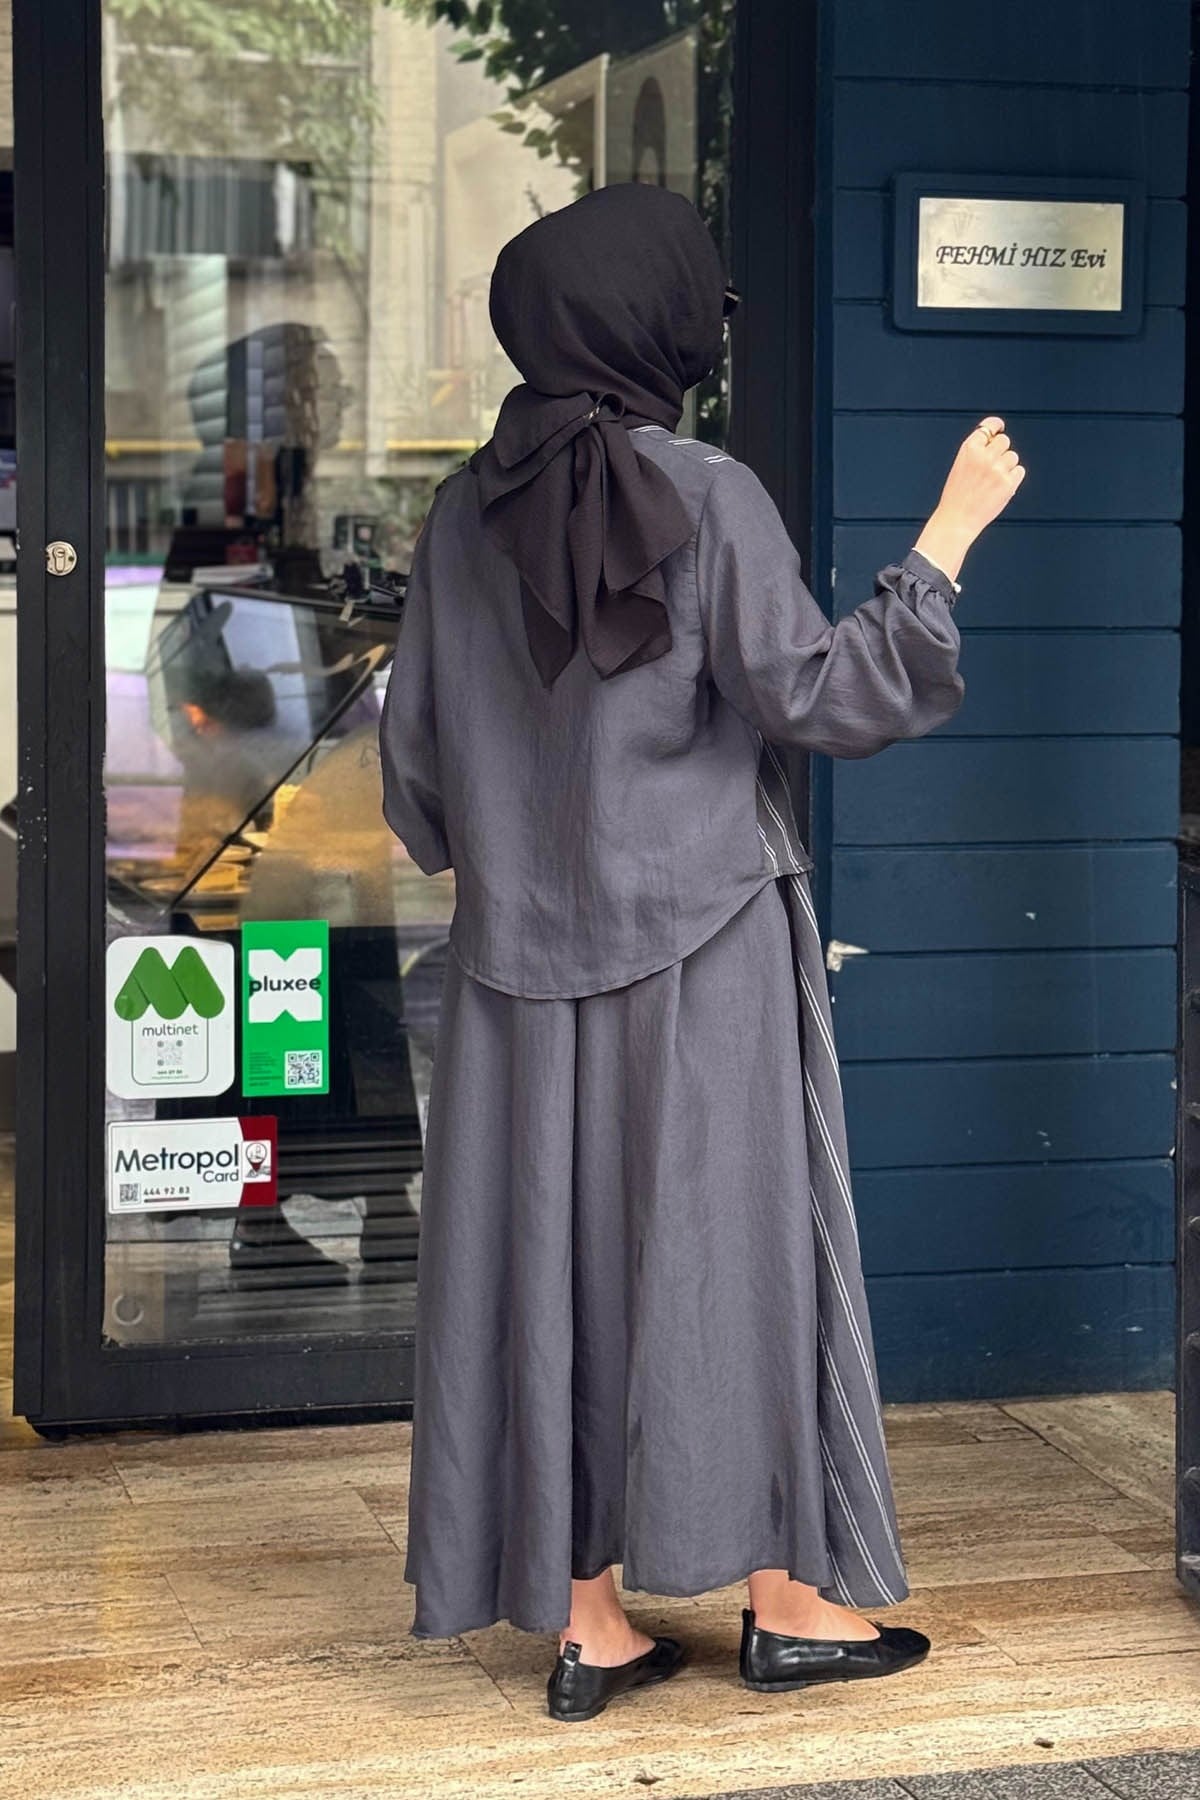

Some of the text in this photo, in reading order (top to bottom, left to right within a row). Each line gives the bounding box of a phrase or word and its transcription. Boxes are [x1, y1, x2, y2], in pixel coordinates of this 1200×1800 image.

[1020, 246, 1067, 268] HIZ
[1070, 249, 1107, 268] Evi
[249, 975, 322, 998] pluxee
[142, 1023, 199, 1037] multinet
[115, 1143, 239, 1174] Metropol
[202, 1169, 239, 1183] Card
[143, 1187, 161, 1196] 444
[164, 1186, 175, 1195] 92
